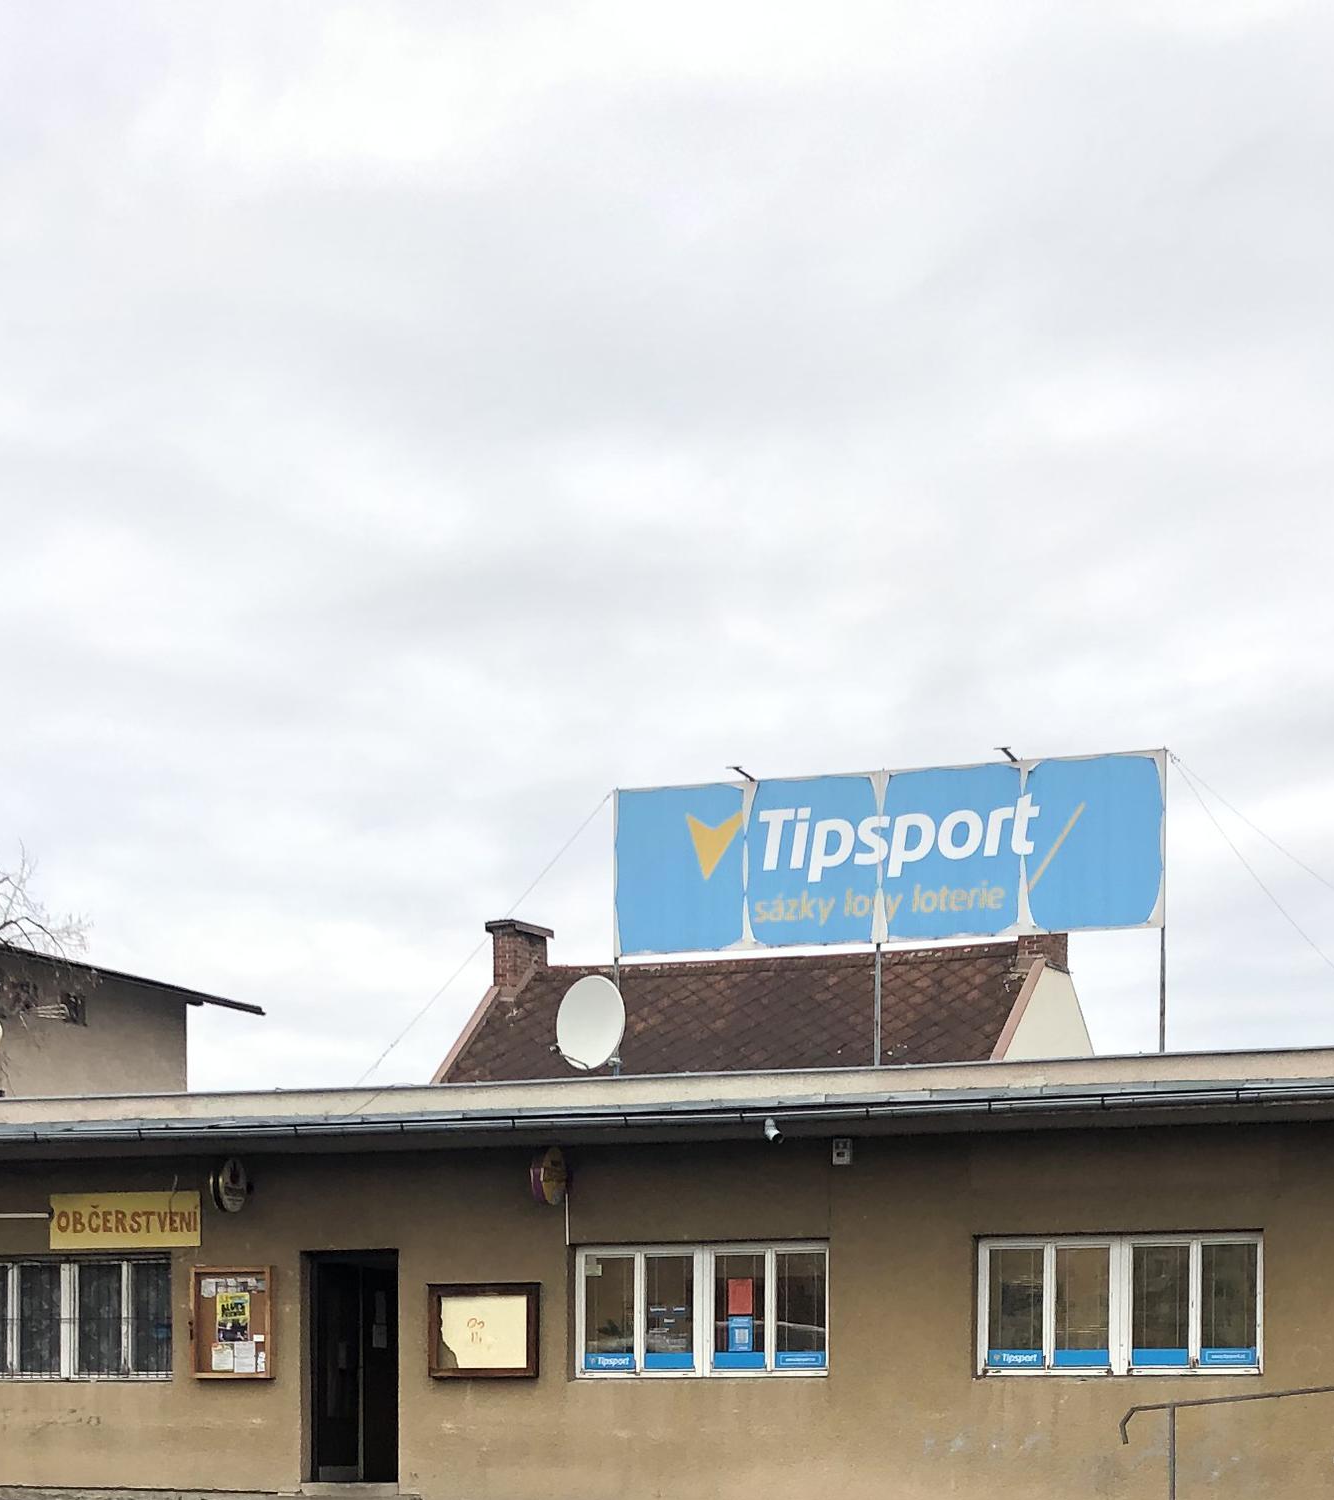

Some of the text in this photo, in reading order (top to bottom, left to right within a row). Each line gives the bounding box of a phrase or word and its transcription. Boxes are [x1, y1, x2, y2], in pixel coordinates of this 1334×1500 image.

[758, 793, 1041, 883] Tipsport
[754, 879, 1006, 927] sázky loy loterie
[56, 1204, 199, 1234] OBČERSTVENÍ
[597, 1356, 630, 1368] Tipsport
[1002, 1352, 1039, 1364] Tipsport
